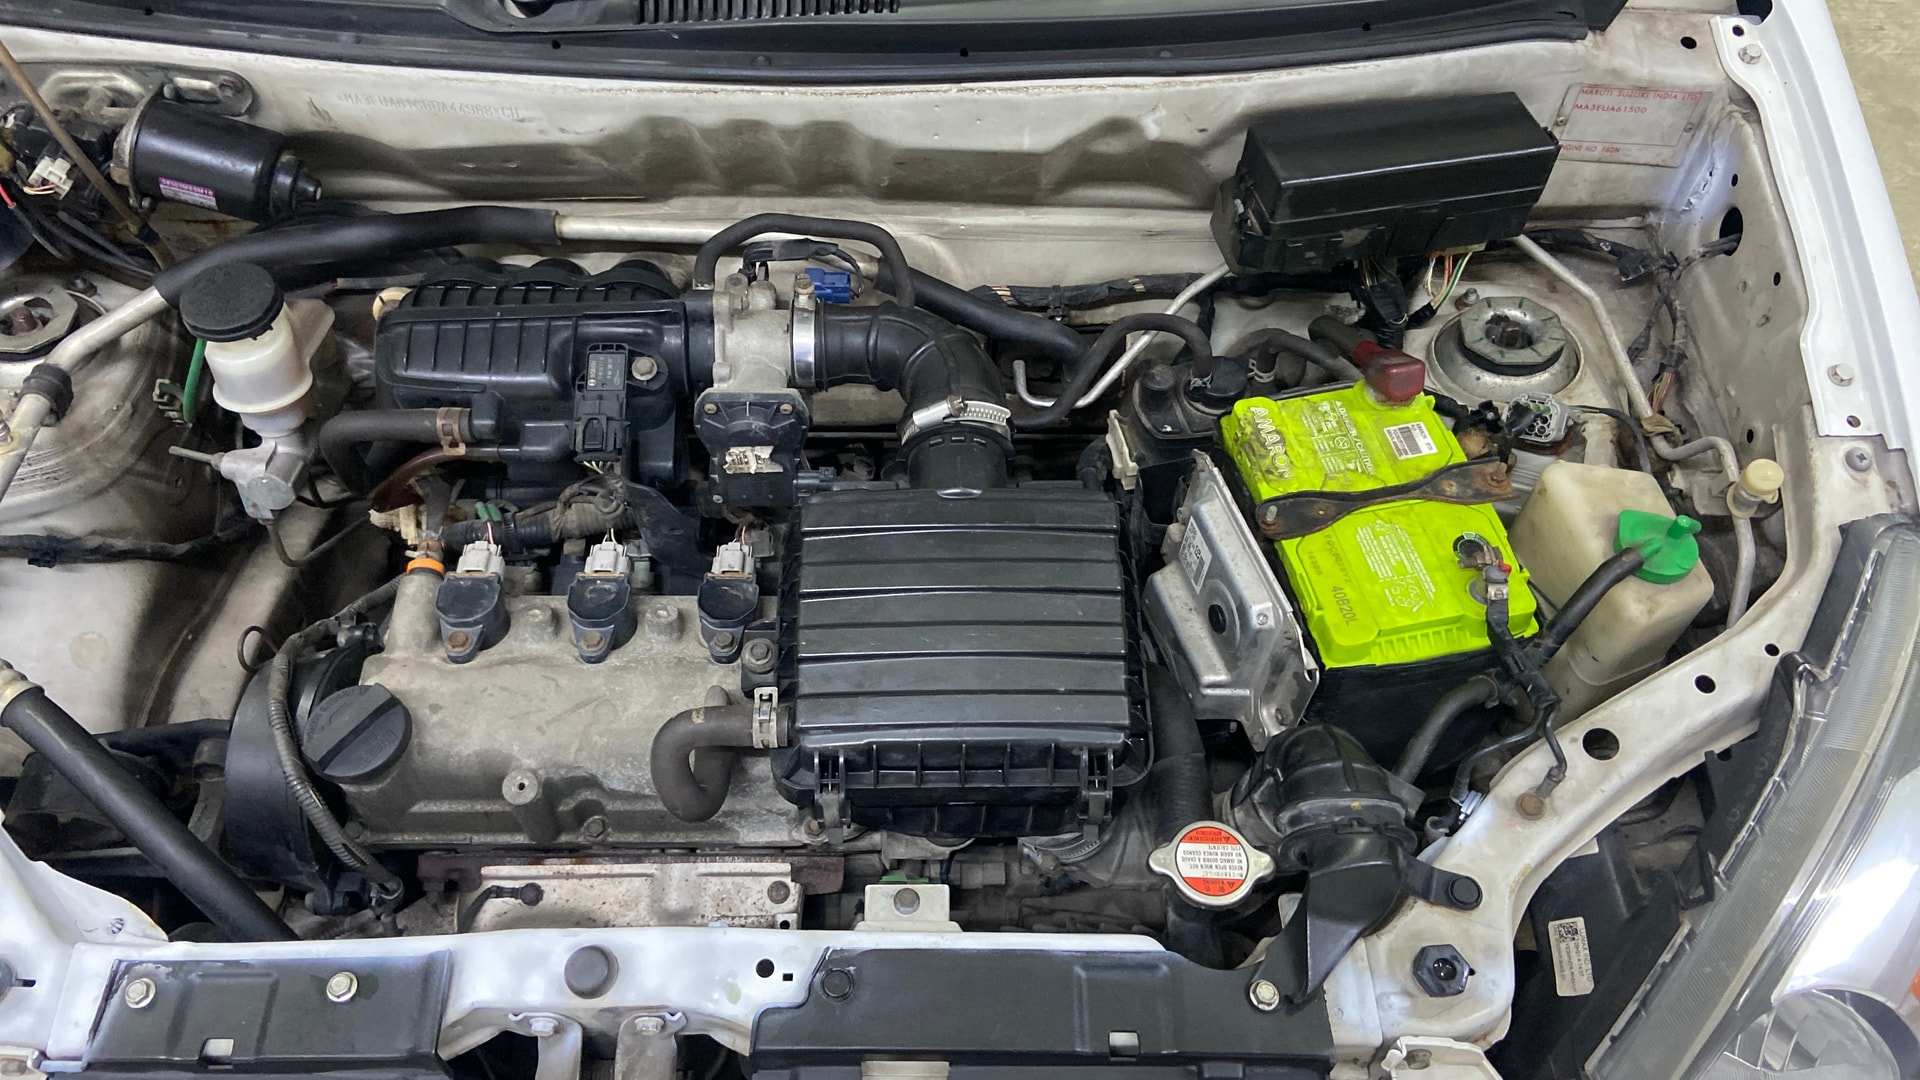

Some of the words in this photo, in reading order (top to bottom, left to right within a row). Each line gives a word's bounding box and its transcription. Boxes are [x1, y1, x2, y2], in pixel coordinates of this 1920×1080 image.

[1580, 88, 1613, 97] MARUTI
[1616, 90, 1649, 98] SUZUKI
[1653, 92, 1678, 100] INDIA
[1250, 406, 1295, 479] AMARON
[1332, 585, 1358, 626] 40B20L
